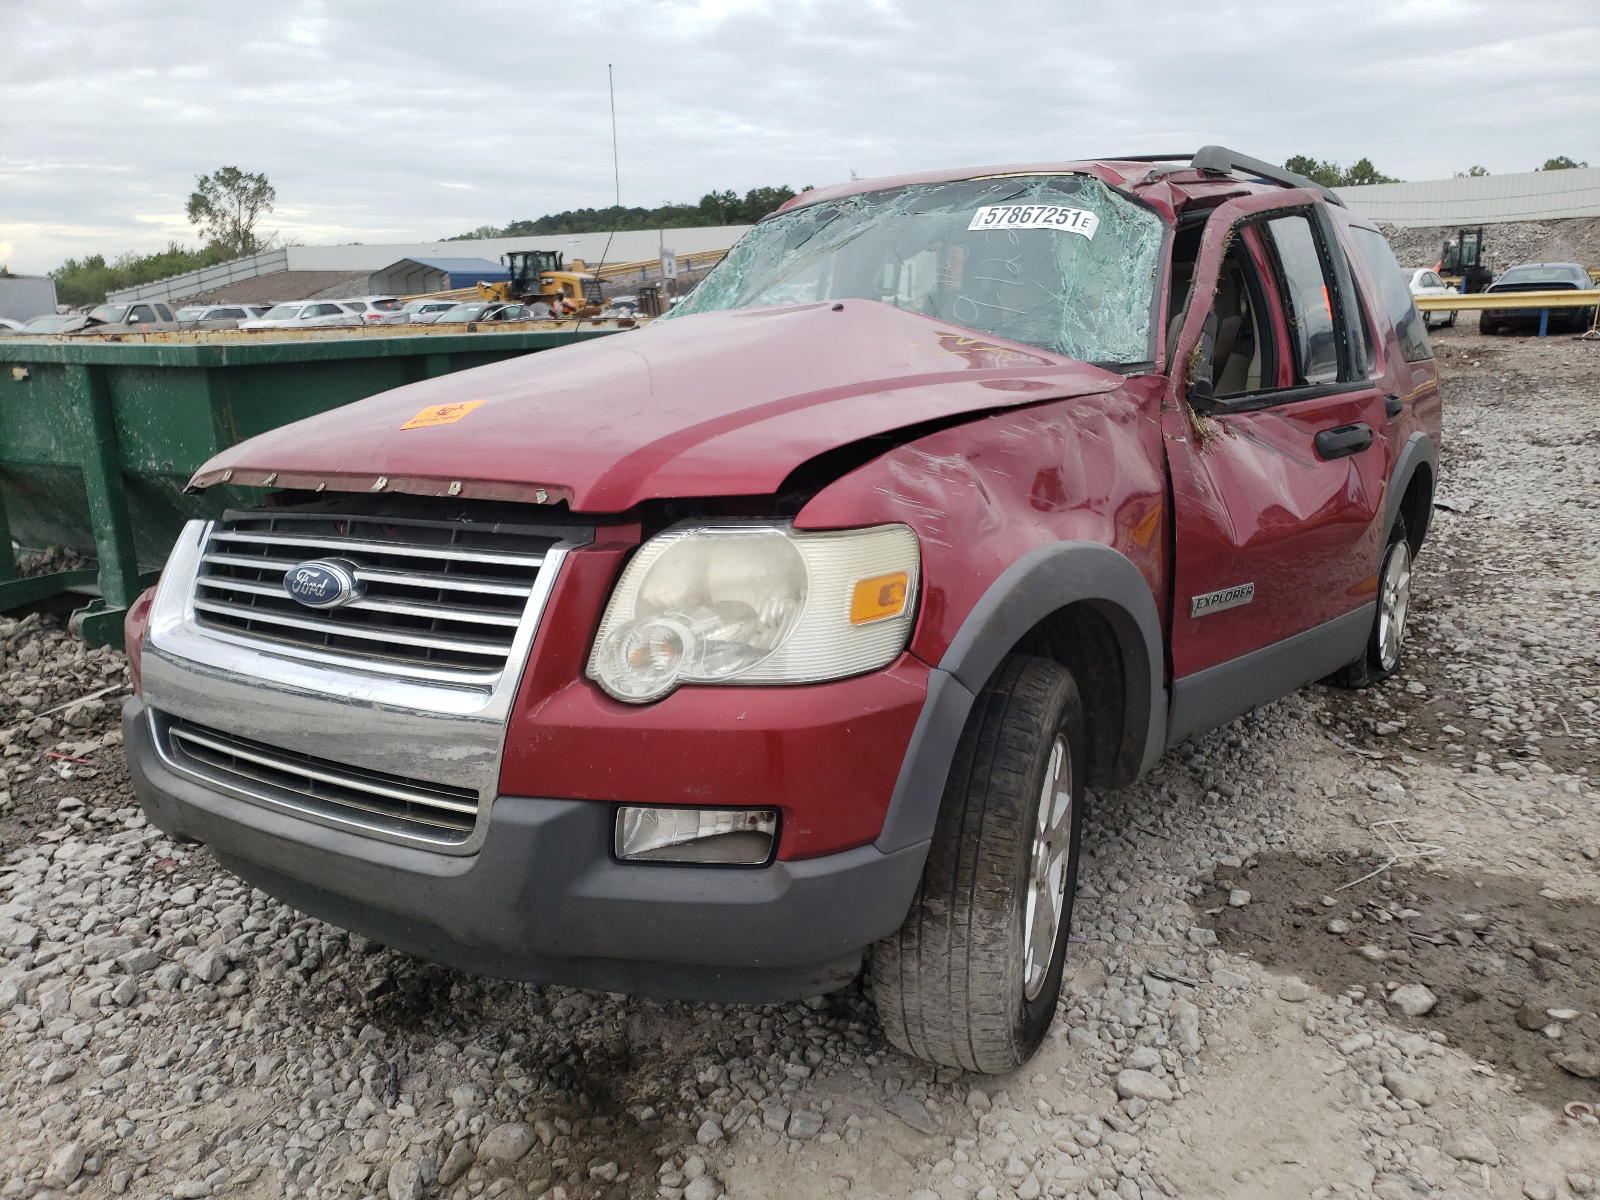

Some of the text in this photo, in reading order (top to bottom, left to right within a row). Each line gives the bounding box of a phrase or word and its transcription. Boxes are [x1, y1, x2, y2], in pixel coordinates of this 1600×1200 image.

[984, 206, 1081, 227] 57867251
[1081, 217, 1091, 228] E
[292, 569, 328, 597] Ford
[1196, 586, 1254, 609] EXPLORER
